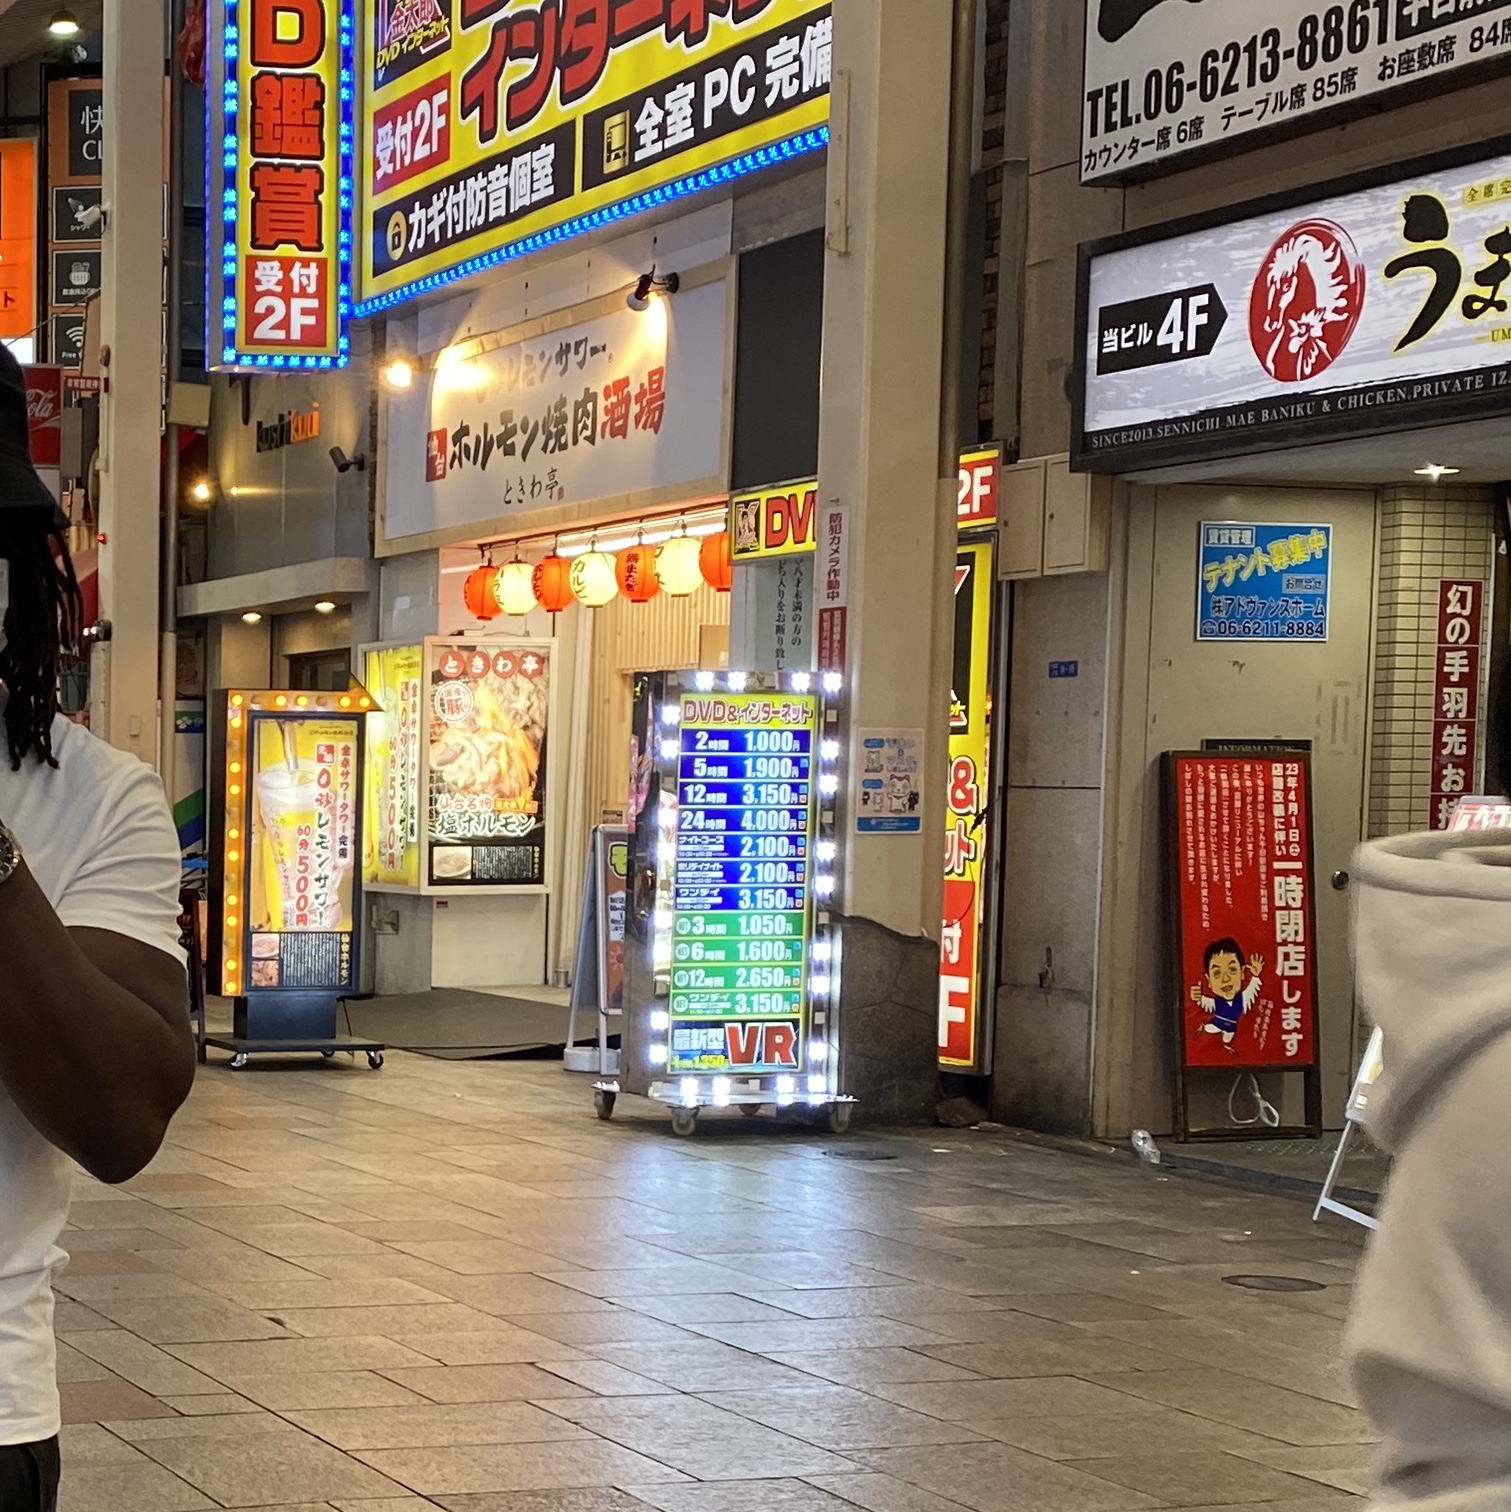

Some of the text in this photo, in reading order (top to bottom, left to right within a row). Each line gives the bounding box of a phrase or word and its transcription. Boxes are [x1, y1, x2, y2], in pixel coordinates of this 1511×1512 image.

[376, 41, 401, 69] DVD
[1087, 0, 1387, 138] TEL.06-6213-8861
[634, 16, 832, 162] 全室 PC 完備
[1083, 125, 1171, 173] カウンター席
[1176, 115, 1204, 143] 6席
[1220, 82, 1307, 132] テーブル席
[1312, 66, 1359, 103] 85席
[1378, 35, 1456, 82] お座敷席
[375, 89, 448, 181] 受付2F
[408, 142, 556, 252] カギ付防音個室
[255, 260, 319, 293] 受付
[253, 295, 319, 341] 2F
[1102, 293, 1209, 354] 当ビル 4F
[62, 352, 78, 360] Free
[449, 366, 666, 471] ホルモン焼肉酒場
[1261, 401, 1316, 423] BANIKU
[1322, 400, 1331, 412] &
[503, 467, 559, 505] ときわ亭
[765, 499, 816, 548] DV
[827, 512, 843, 601] 防犯カメラ作動中
[1204, 528, 1327, 592] テナント募集中
[573, 559, 589, 599] カルビ
[1218, 620, 1324, 636] 06-6211-8884
[444, 654, 540, 675] ときわ亭
[446, 697, 465, 716] 豚
[683, 700, 812, 724] DVD&インターネット
[695, 731, 730, 751] 2時間
[693, 758, 728, 777] 5時間
[438, 795, 493, 811] 仙台名物
[684, 785, 727, 804] 12時間
[437, 814, 536, 837] 塩ホルモン
[681, 811, 726, 830] 24時間
[1272, 860, 1306, 1057] 一時閉店します
[673, 1022, 798, 1068] 最新型 VR
